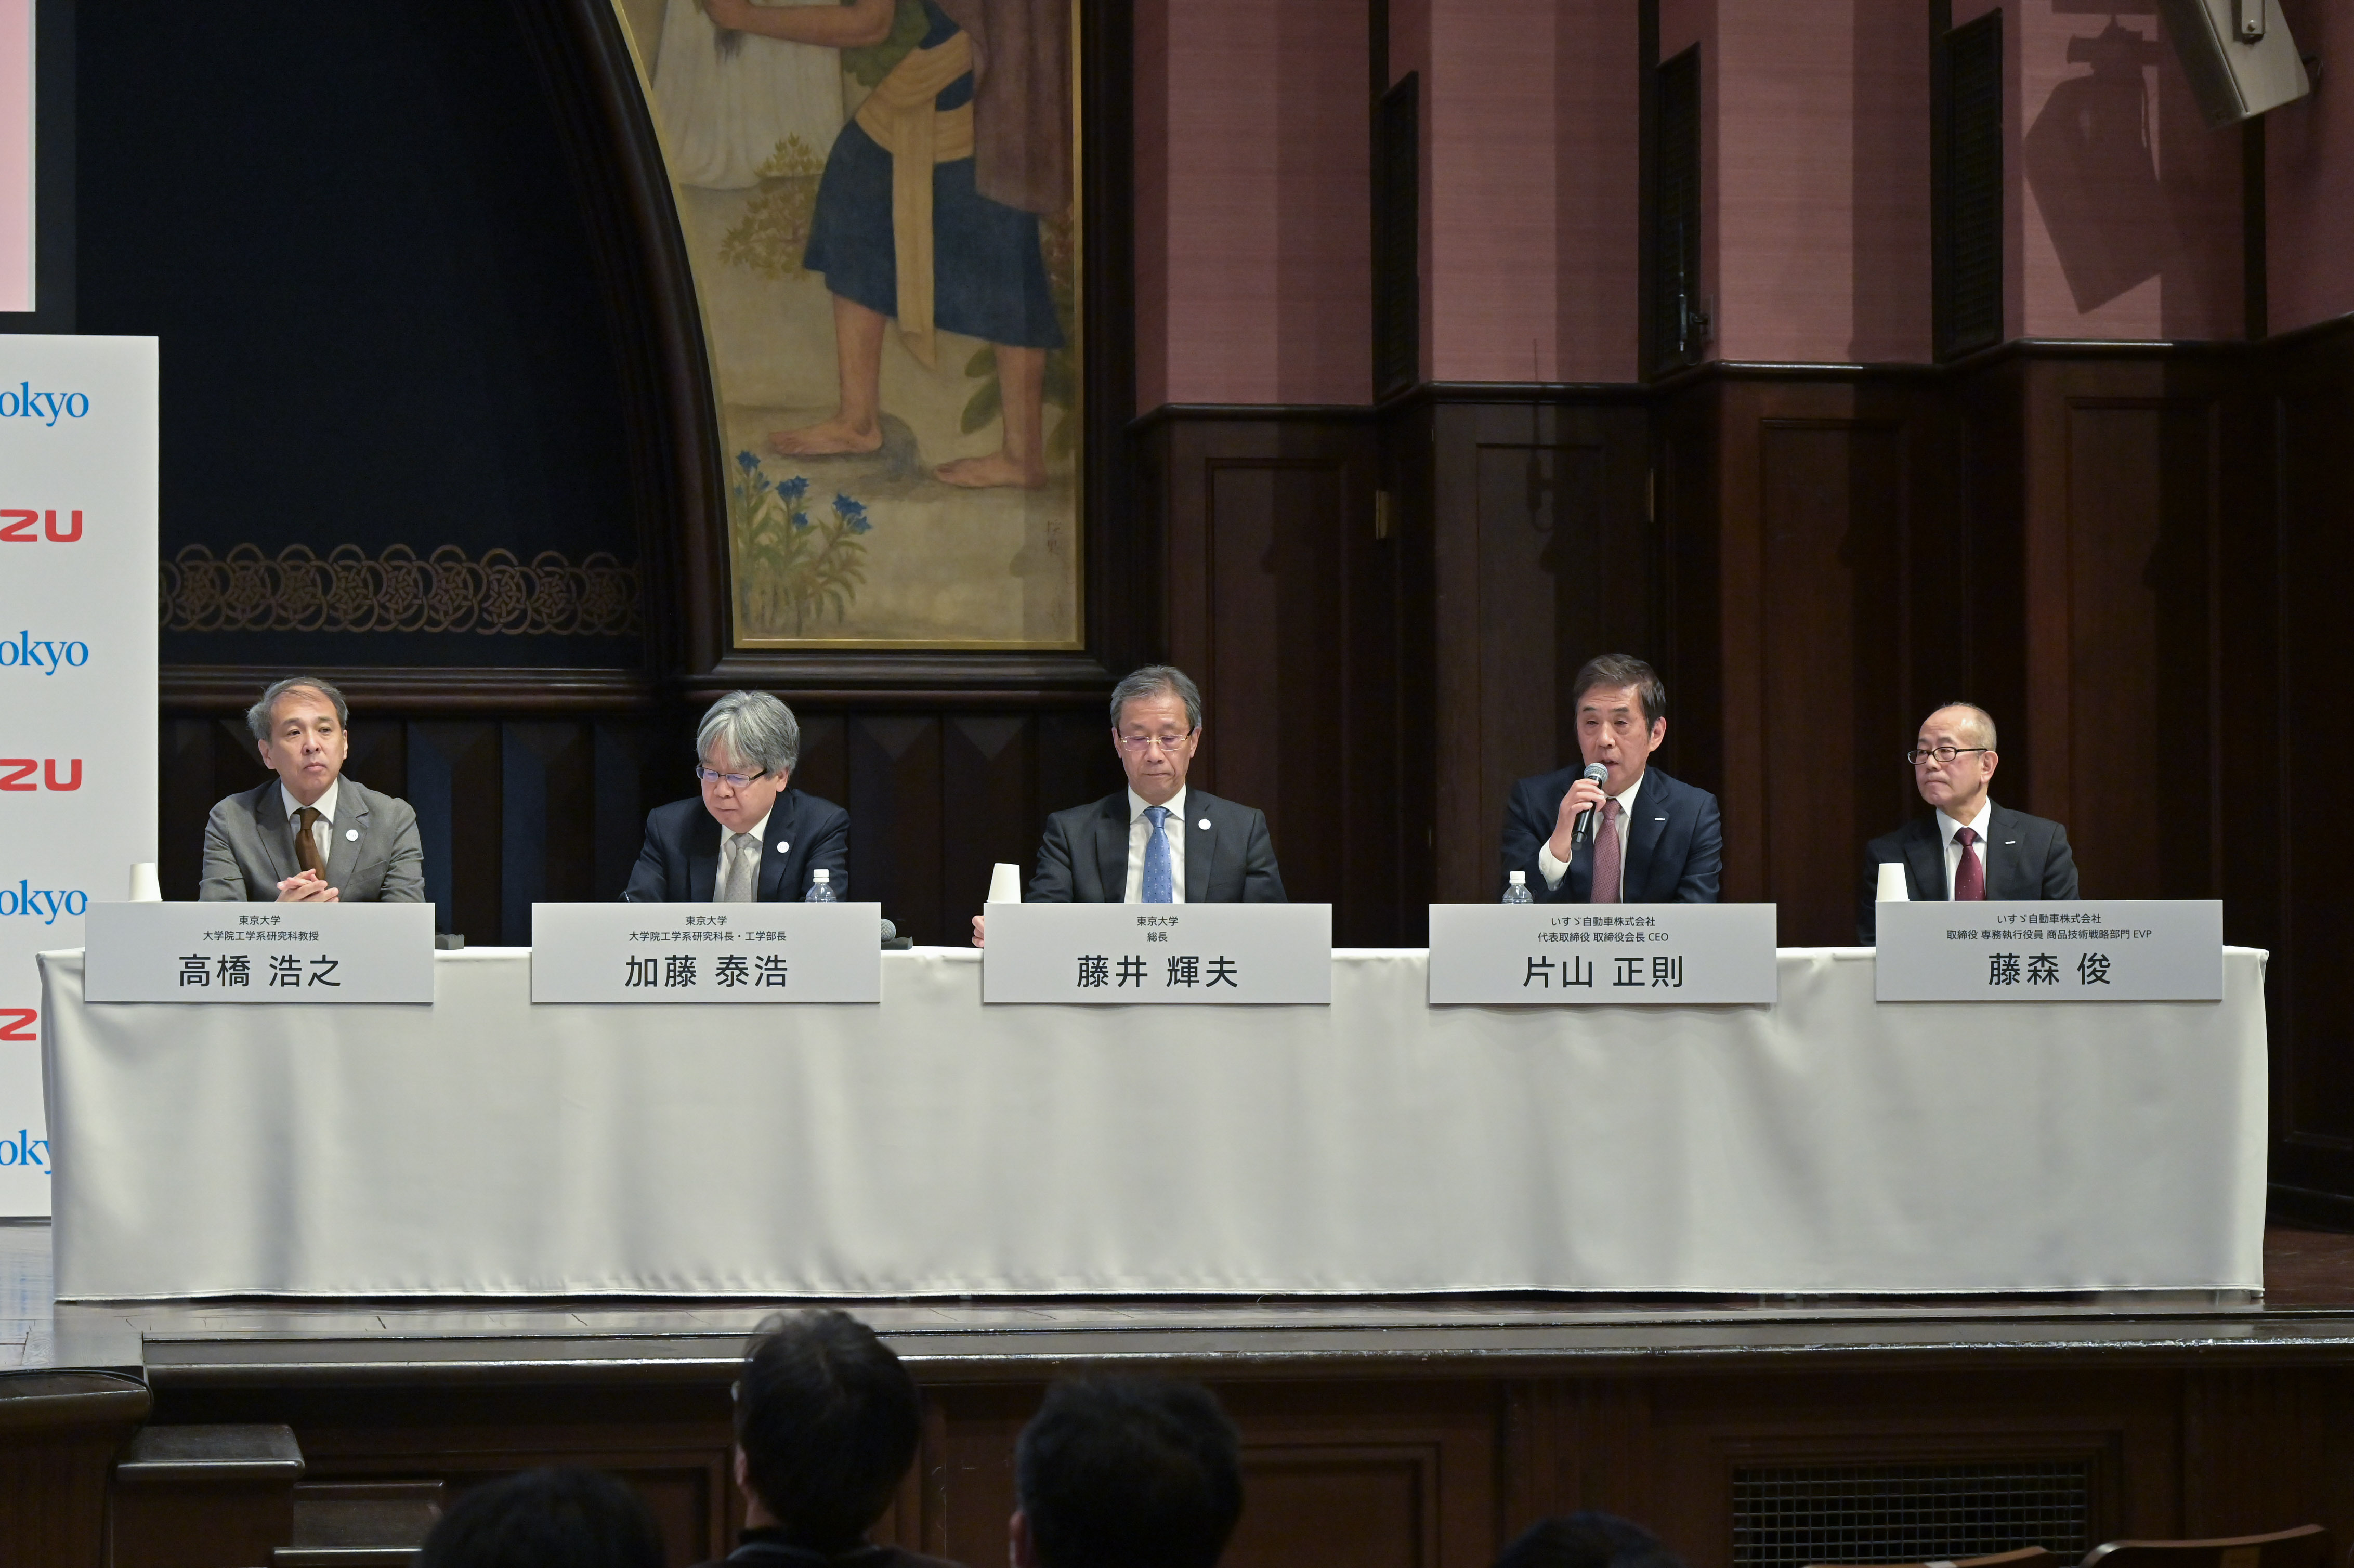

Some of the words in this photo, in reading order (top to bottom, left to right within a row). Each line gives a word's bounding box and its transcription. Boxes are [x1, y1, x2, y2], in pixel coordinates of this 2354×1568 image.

[239, 915, 280, 925] 東京大学
[686, 915, 727, 926] 東京大学
[1136, 916, 1179, 926] 東京大学
[1551, 916, 1656, 927] いすゞ自動車株式会社
[1997, 913, 2102, 924] いすゞ自動車株式会社
[203, 931, 319, 941] 大学院工学系研究科教授
[629, 931, 787, 942] 大学院工学系研究科長・工学部長
[1147, 932, 1168, 942] 総長
[1538, 932, 1590, 943] 代表取締役
[1593, 932, 1645, 943] 取締役会長
[1648, 933, 1669, 942] CEO
[1946, 930, 1978, 940] 取締役
[1981, 929, 2043, 940] 専務執行役員
[2047, 929, 2130, 939] 商品技術戦略部門
[2133, 930, 2152, 938] EVP
[179, 953, 250, 987] 高橋
[269, 954, 341, 987] 浩之
[625, 954, 697, 987] 加藤
[715, 954, 788, 987] 泰浩
[1077, 955, 1148, 988] 藤井
[1166, 955, 1238, 988] 輝夫
[1523, 955, 1592, 988] 片山
[1613, 955, 1682, 988] 正則
[1989, 952, 2060, 986] 藤森
[2076, 952, 2111, 985] 俊
